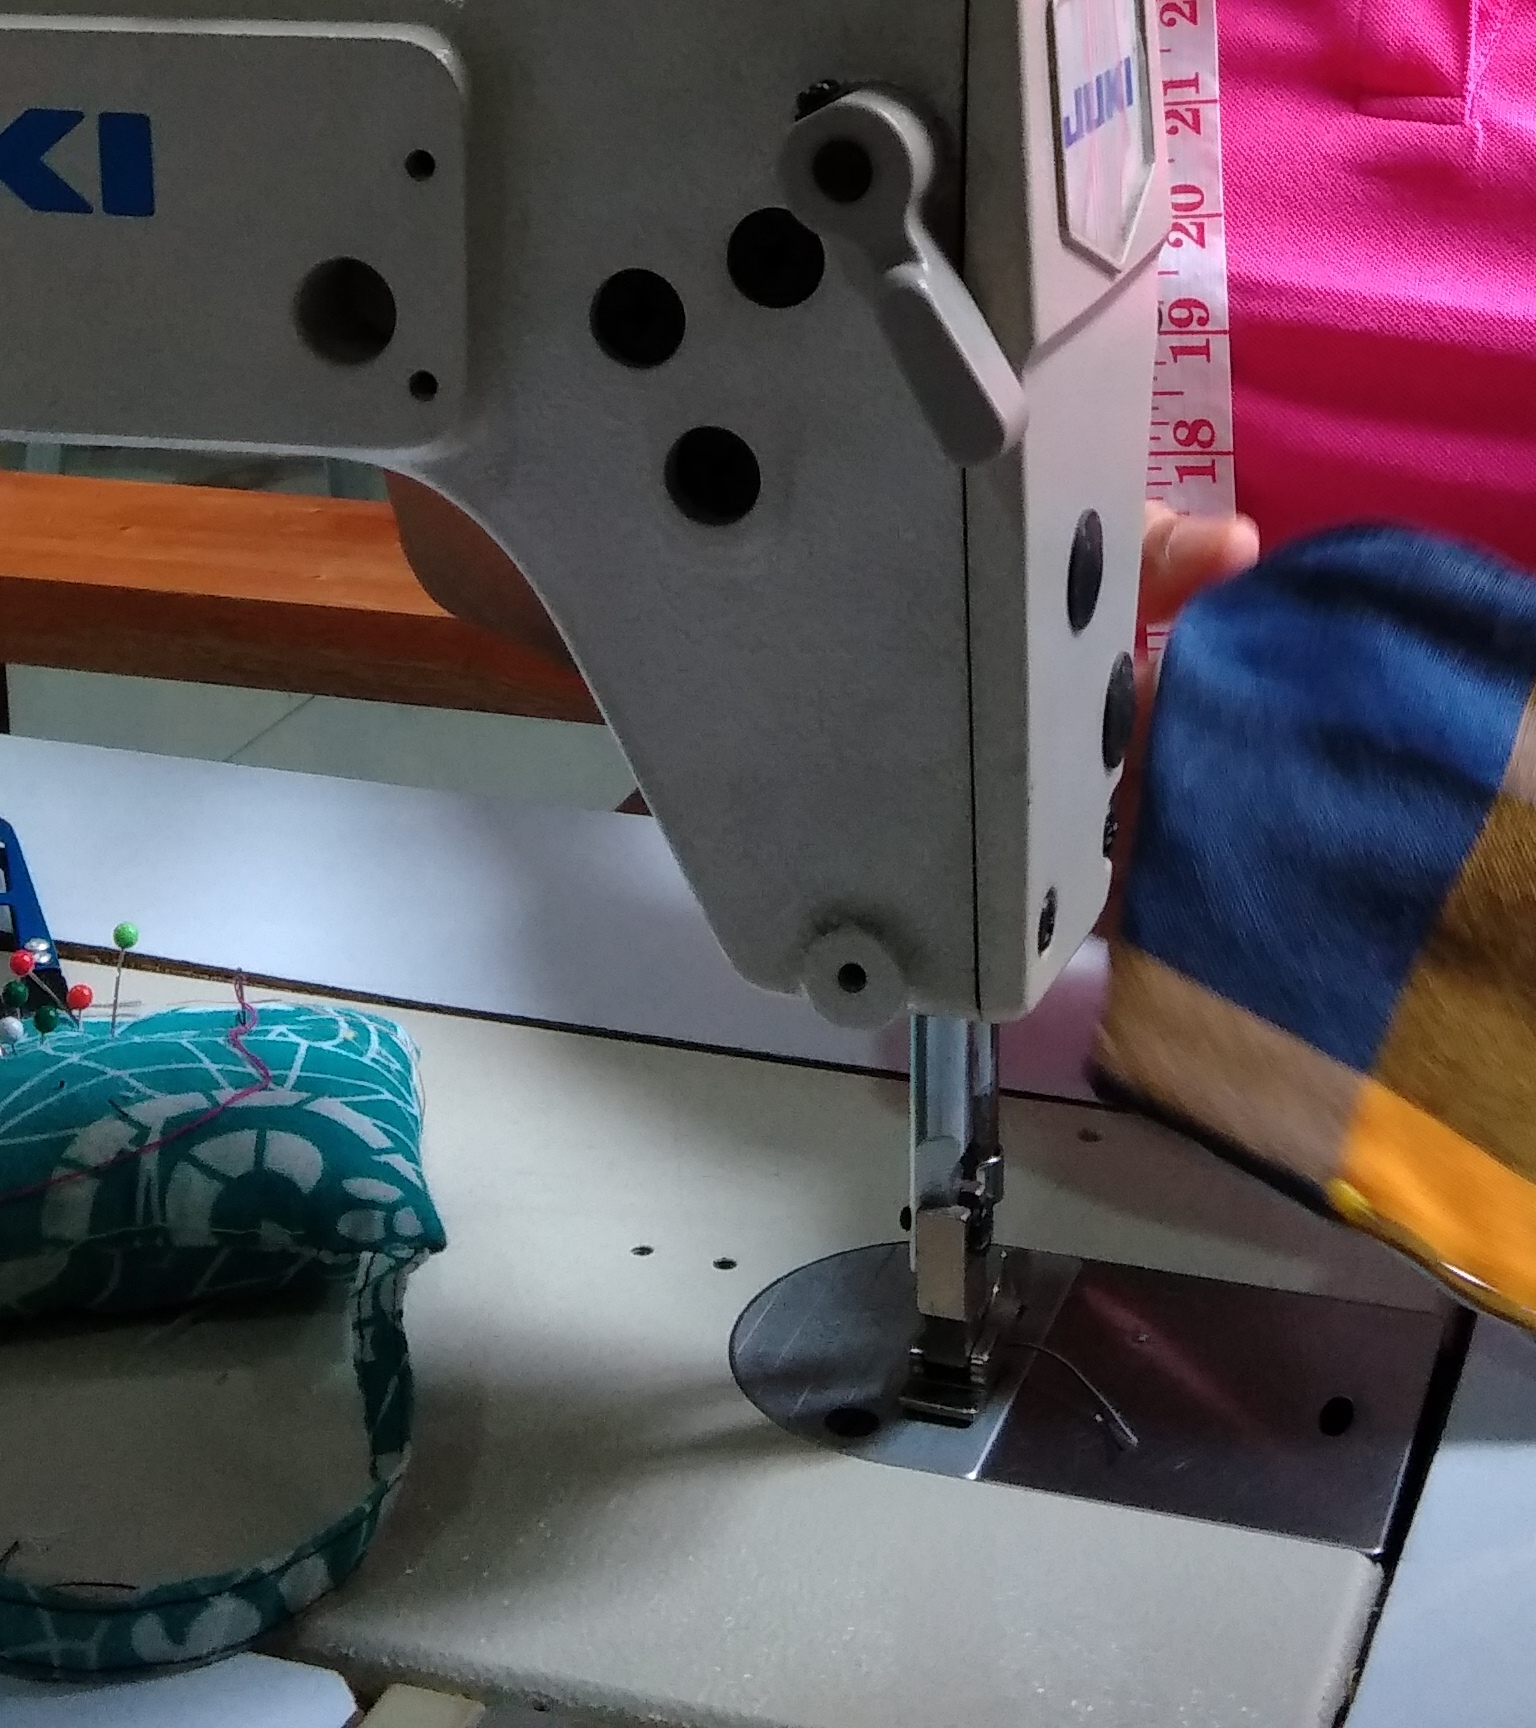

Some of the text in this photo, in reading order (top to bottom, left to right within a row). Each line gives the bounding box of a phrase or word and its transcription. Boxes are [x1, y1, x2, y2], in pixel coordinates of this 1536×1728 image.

[1064, 56, 1133, 149] JUKI
[1162, 72, 1202, 136] 21
[1166, 184, 1205, 250] 20
[1168, 297, 1211, 363] 19
[1173, 418, 1217, 484] 18
